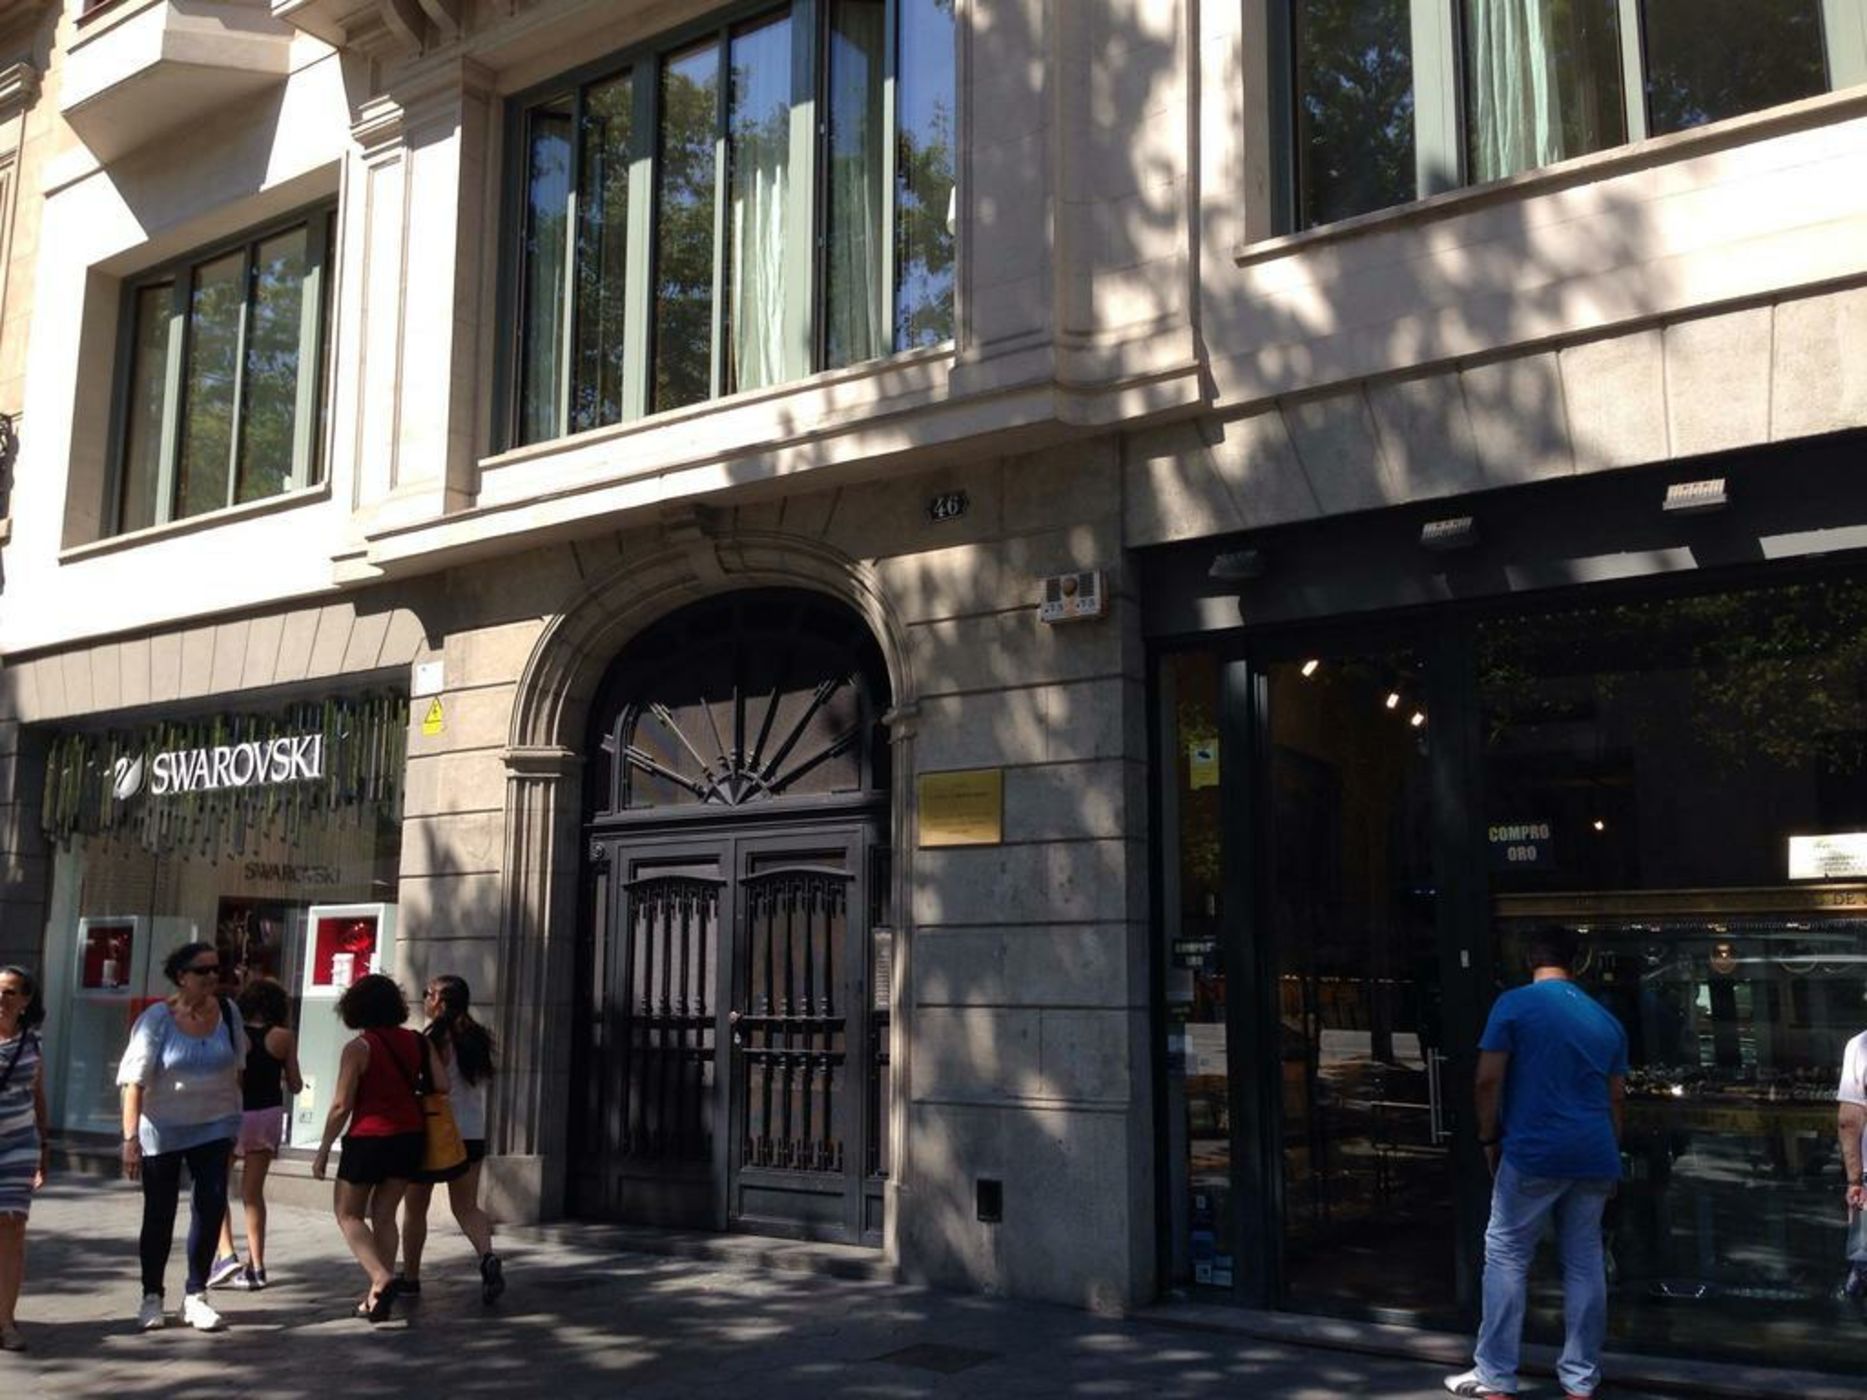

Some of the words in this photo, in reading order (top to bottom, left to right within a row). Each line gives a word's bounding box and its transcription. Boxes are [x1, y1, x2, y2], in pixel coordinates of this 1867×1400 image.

[934, 496, 959, 517] 46
[151, 734, 323, 795] SWAROVSKI
[1489, 824, 1550, 842] COMPRO
[1508, 845, 1537, 861] ORO
